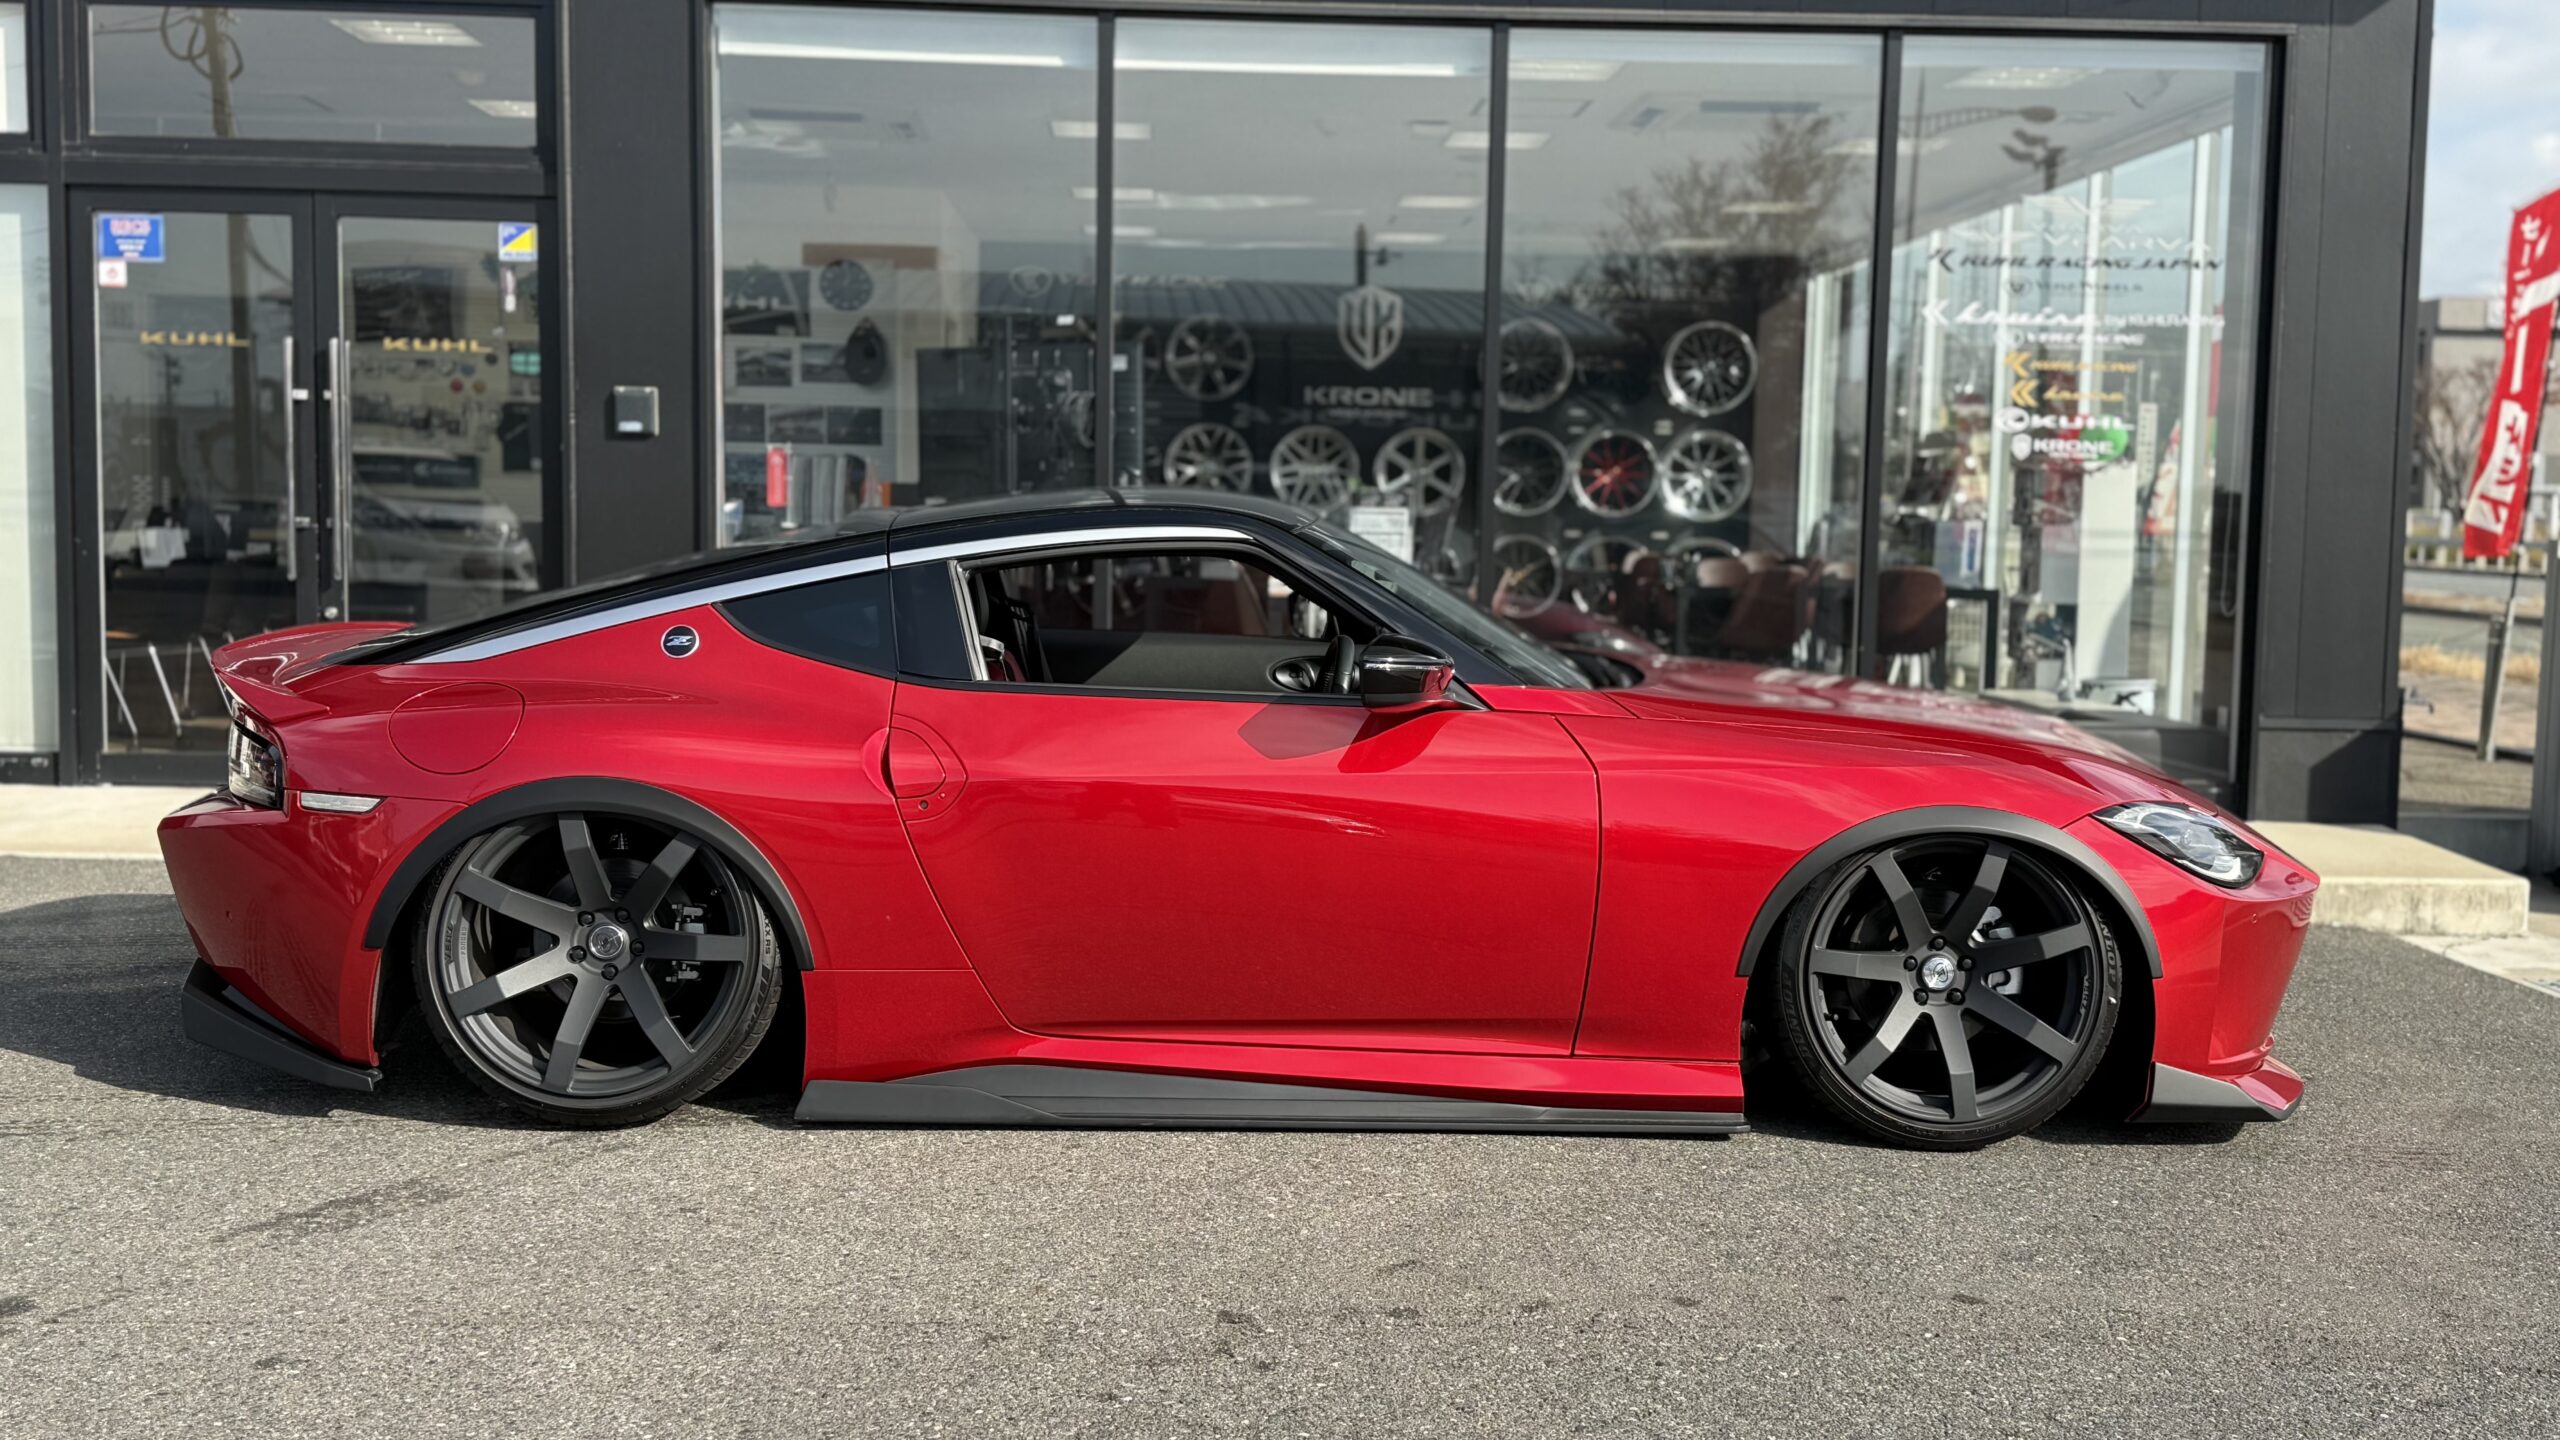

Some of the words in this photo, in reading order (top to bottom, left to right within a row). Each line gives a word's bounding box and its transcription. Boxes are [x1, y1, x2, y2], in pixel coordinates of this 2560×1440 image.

[139, 330, 250, 347] KUHL
[383, 336, 494, 353] KUHL
[1303, 385, 1434, 408] KRONE
[2031, 414, 2135, 430] KUHL
[2033, 439, 2113, 455] KRONE
[2092, 900, 2117, 990] UNLOP
[1783, 970, 1813, 1059] DUNLOP
